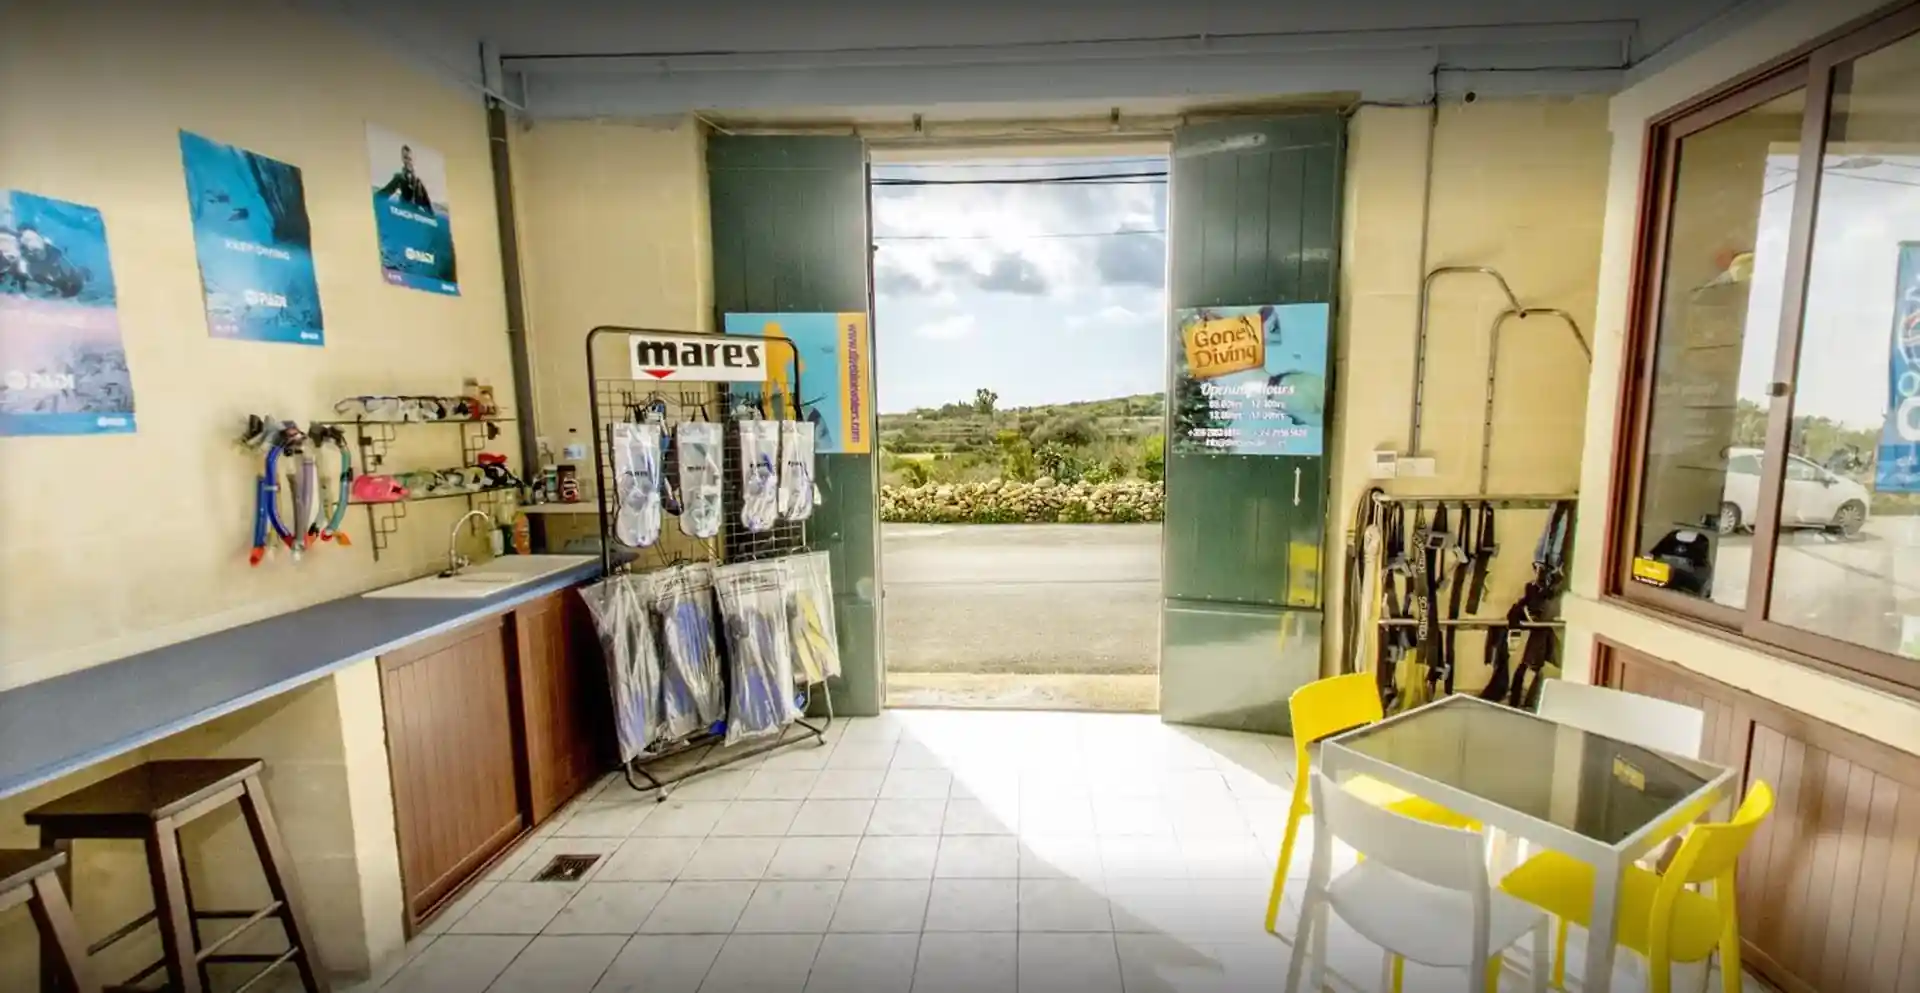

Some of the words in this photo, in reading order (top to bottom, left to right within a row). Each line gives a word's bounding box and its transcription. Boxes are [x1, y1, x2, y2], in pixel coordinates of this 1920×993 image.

[1194, 326, 1247, 348] Gone
[636, 340, 760, 368] mares
[1194, 343, 1258, 368] Diving
